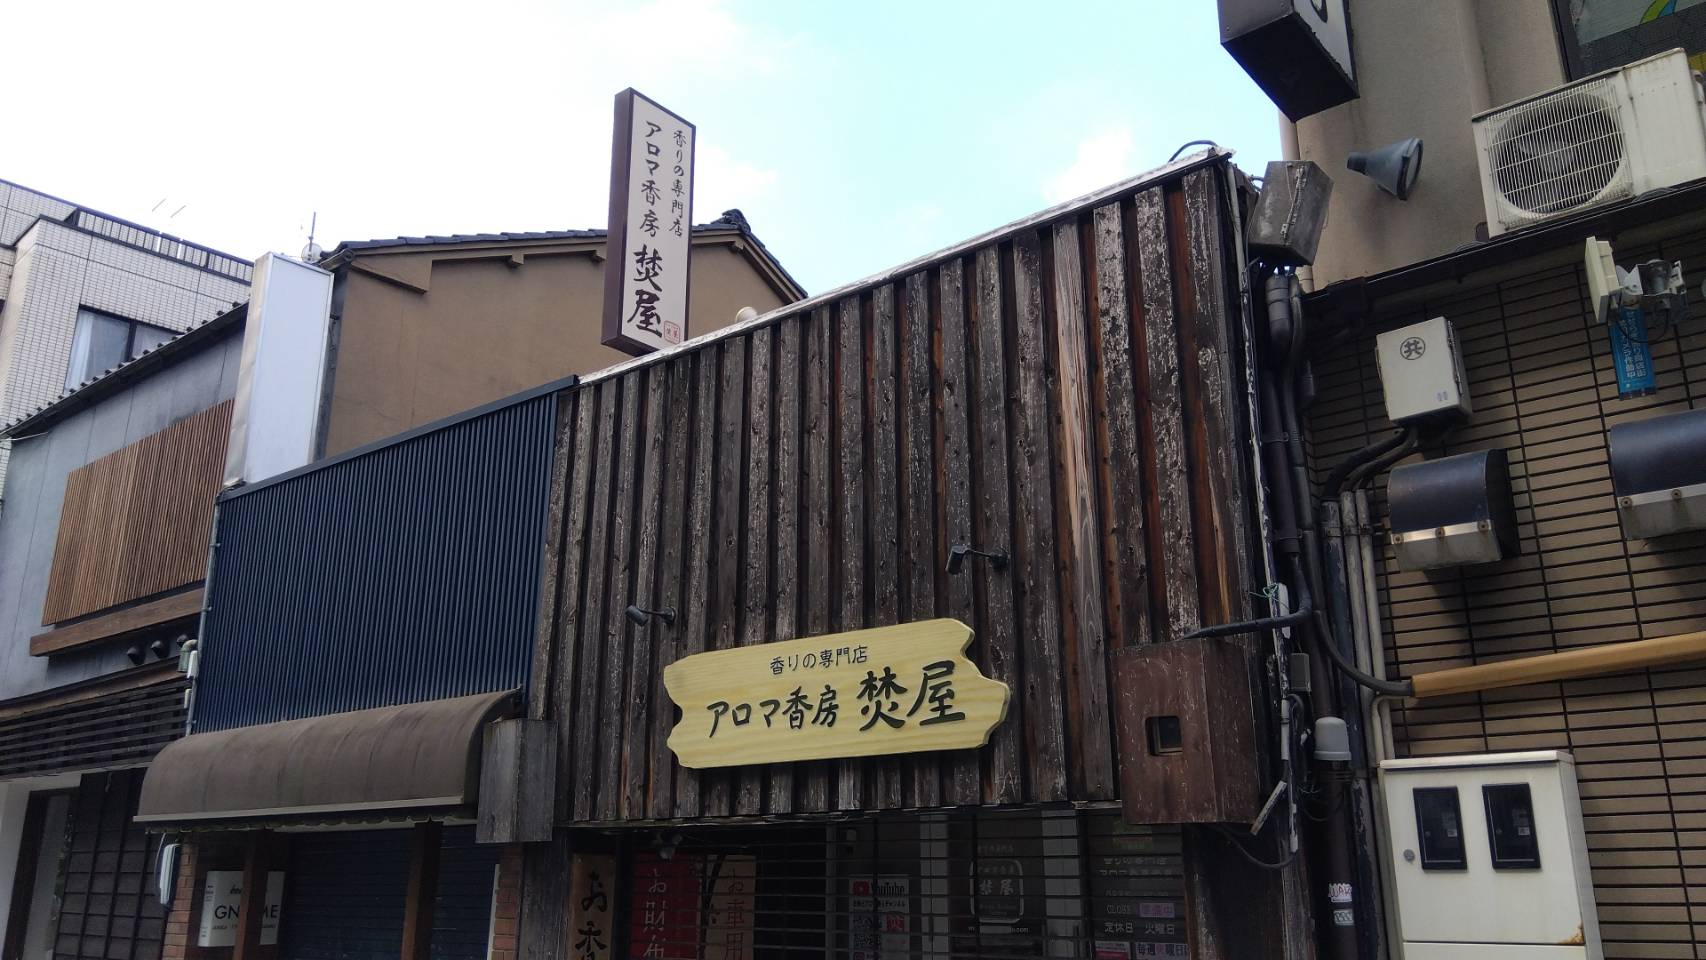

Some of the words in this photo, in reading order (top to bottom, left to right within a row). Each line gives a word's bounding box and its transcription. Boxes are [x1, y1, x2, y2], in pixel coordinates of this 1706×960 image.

[639, 120, 662, 238] アロマ香房
[669, 130, 687, 237] 香りの専門店
[770, 644, 868, 675] 香りの専門店
[706, 684, 839, 738] アロマ香房
[214, 904, 280, 920] GNE
[1103, 921, 1134, 934] 定休日
[1144, 922, 1176, 936] 火曜日
